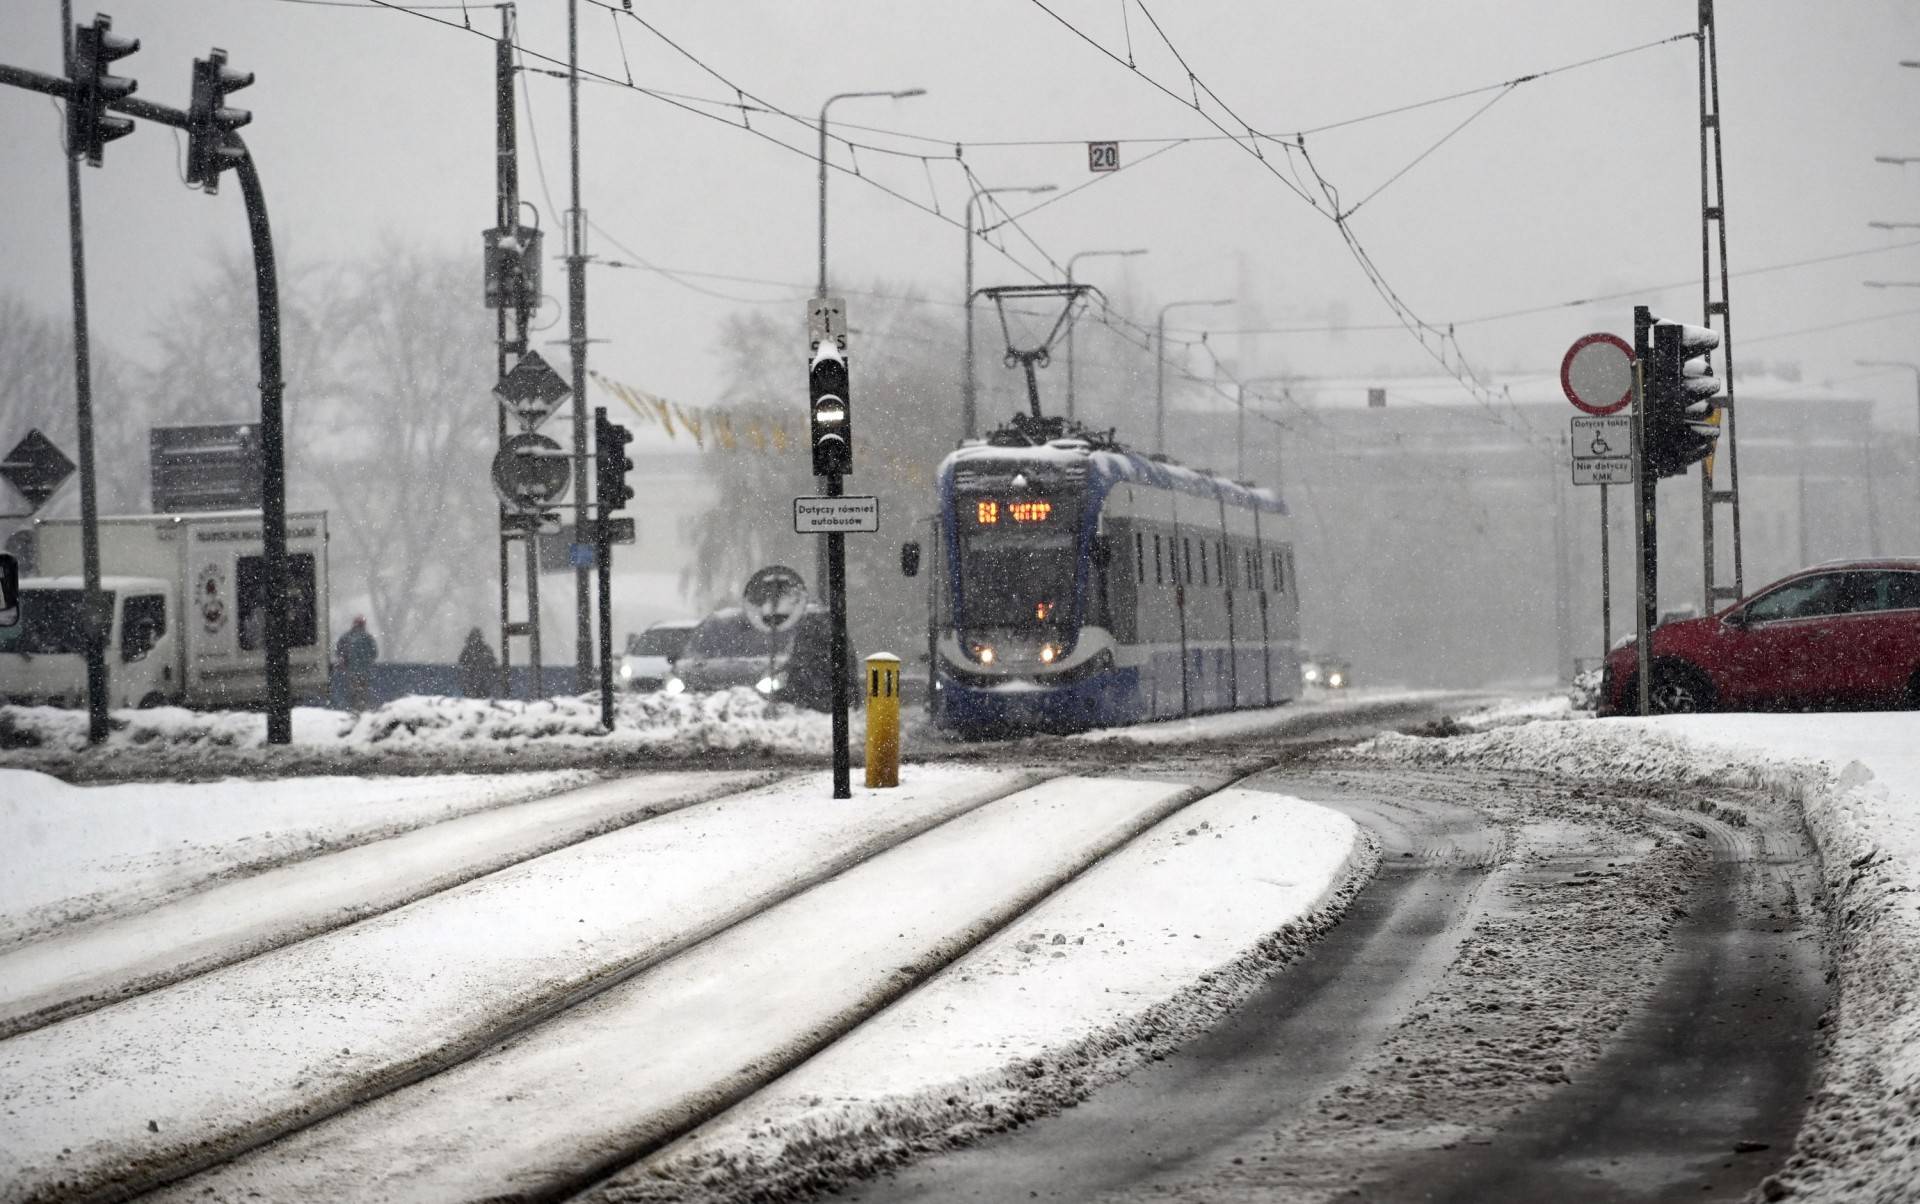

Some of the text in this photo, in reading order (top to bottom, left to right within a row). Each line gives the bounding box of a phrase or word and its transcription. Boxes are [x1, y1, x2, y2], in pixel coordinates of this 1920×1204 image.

[1093, 147, 1116, 167] 20
[1576, 461, 1629, 473] Nie dotyczy
[1592, 473, 1613, 481] KMK
[799, 504, 875, 516] Dotyczy również
[811, 517, 863, 526] autobusów
